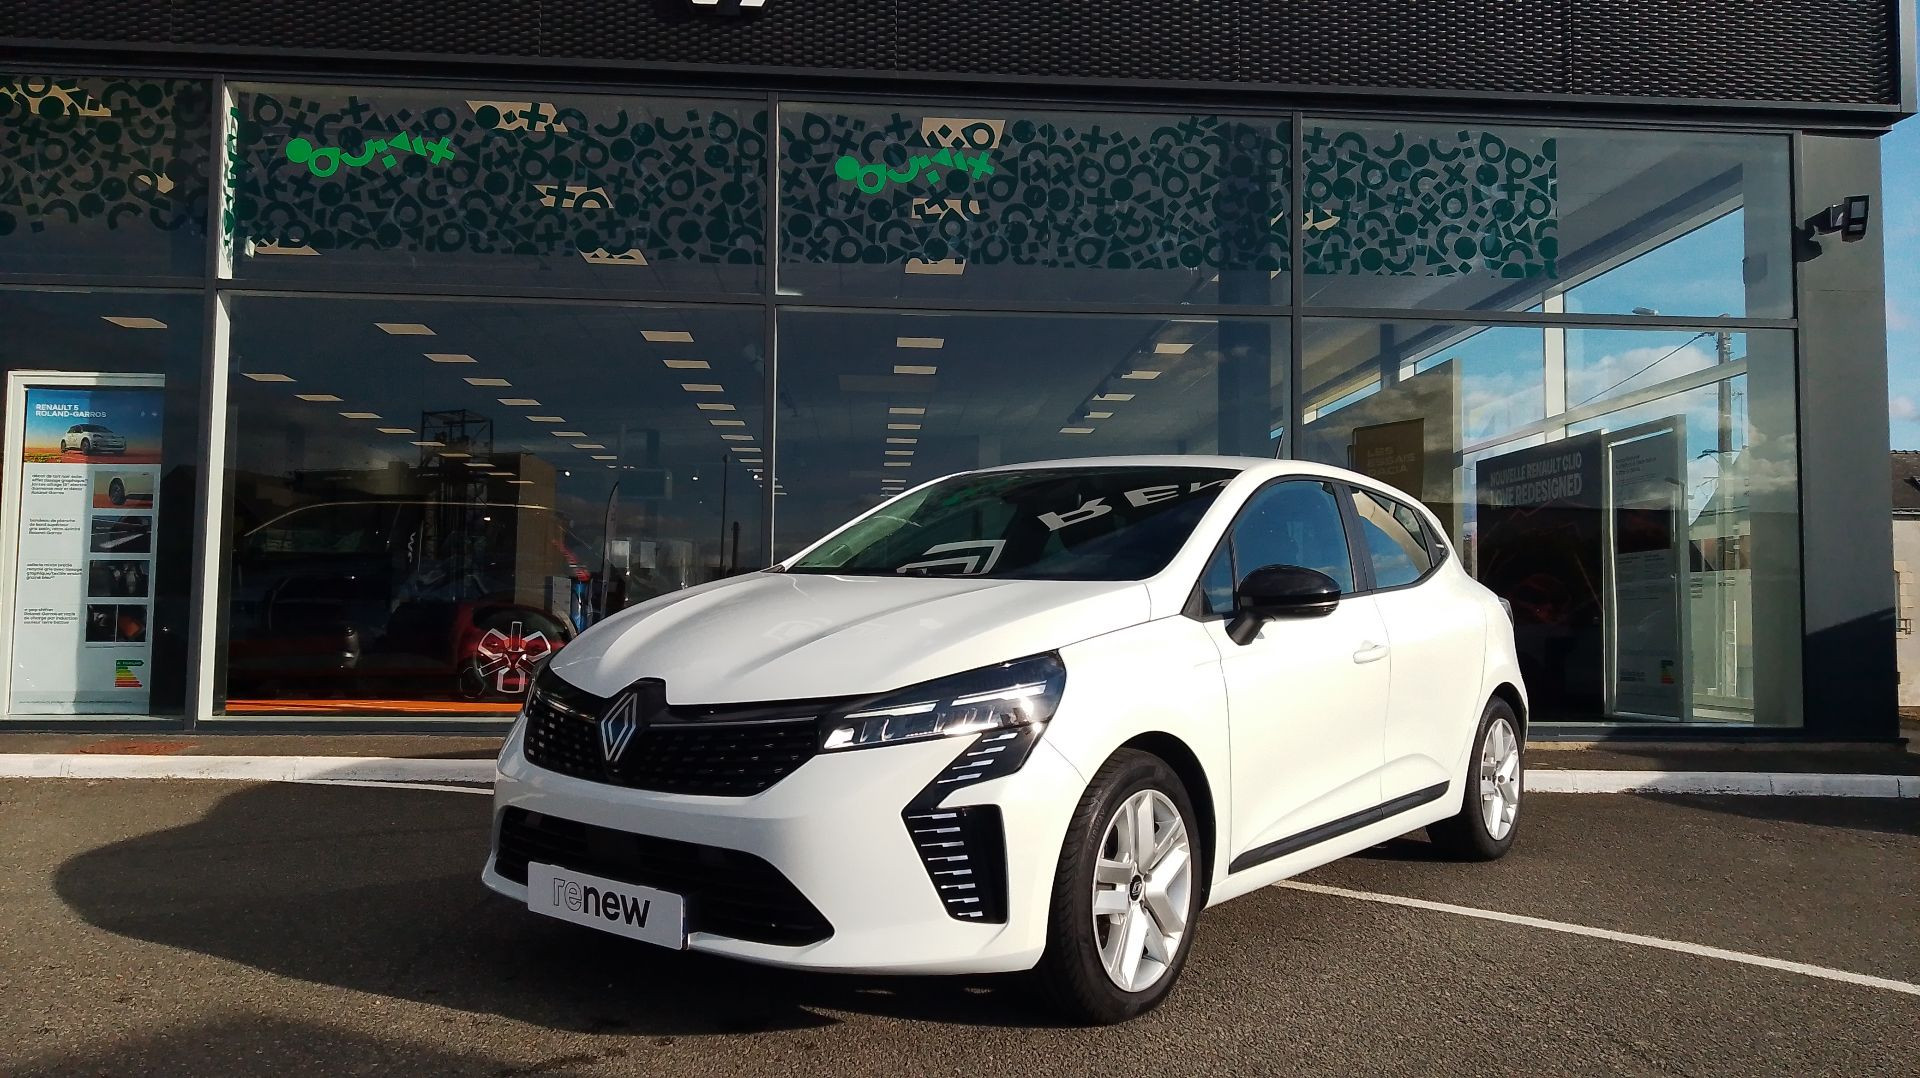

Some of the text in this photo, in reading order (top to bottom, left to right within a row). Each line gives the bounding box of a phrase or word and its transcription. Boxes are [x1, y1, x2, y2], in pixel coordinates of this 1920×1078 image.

[35, 410, 107, 418] ROLAND-GARROS
[1490, 451, 1582, 488] NOUVELLE RENAULT CLIO
[1515, 473, 1583, 505] REDESIGNED
[553, 877, 650, 928] renew
